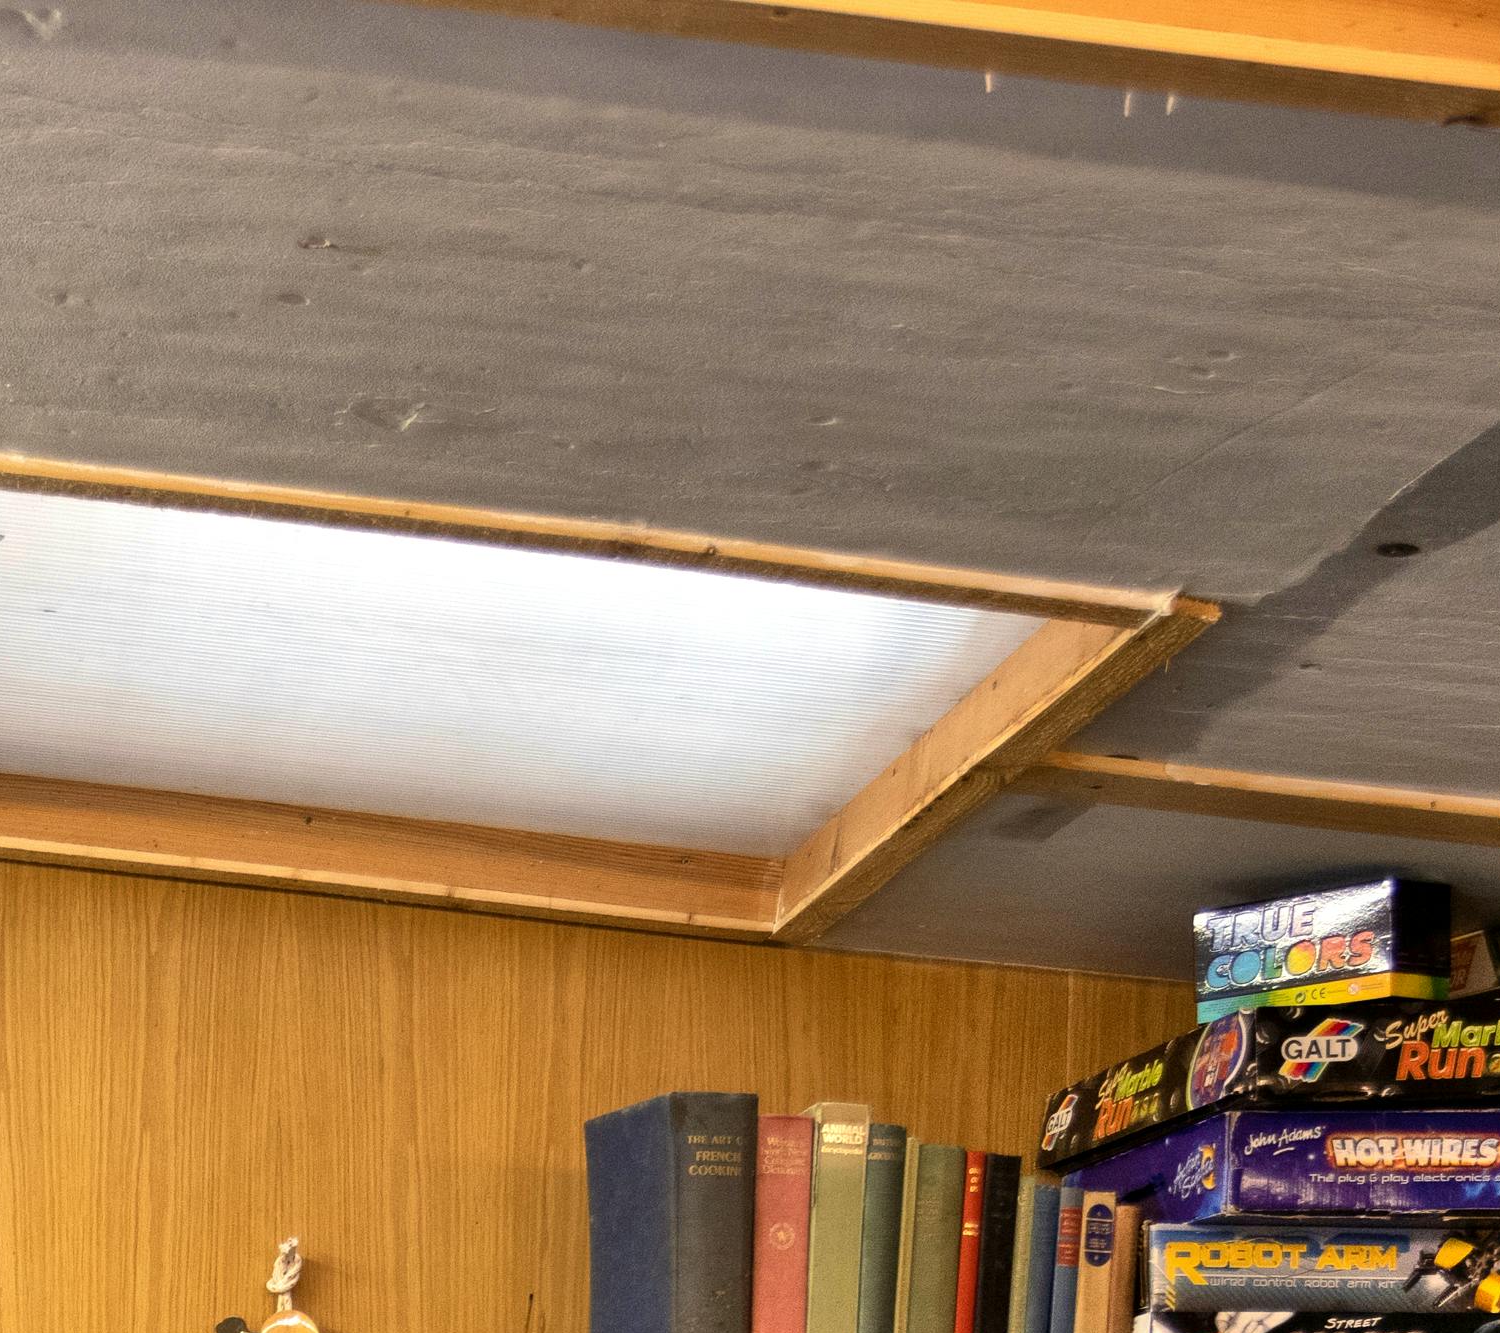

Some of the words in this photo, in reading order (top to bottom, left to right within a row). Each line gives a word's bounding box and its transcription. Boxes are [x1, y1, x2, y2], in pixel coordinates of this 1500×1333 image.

[1206, 901, 1316, 951] TRUE
[1206, 931, 1376, 989] COLORS
[1385, 1009, 1450, 1050] Super
[1284, 1038, 1351, 1059] GALT
[1395, 1041, 1488, 1081] Run
[1114, 1059, 1164, 1100] Marble
[821, 1123, 867, 1136] ANIMAL
[1046, 1110, 1073, 1134] GALT
[1092, 1095, 1135, 1142] Run
[822, 1134, 864, 1146] WORLD
[1244, 1134, 1276, 1156] John
[1277, 1126, 1322, 1147] Adams
[1332, 1137, 1396, 1167] HOT
[1404, 1136, 1500, 1167] WIRES
[1309, 1173, 1334, 1184] The
[1337, 1173, 1365, 1185] plug
[1381, 1173, 1409, 1185] play
[1413, 1173, 1491, 1184] electronics
[1164, 1241, 1307, 1285] ROBOT
[1315, 1244, 1398, 1271] ARM
[1324, 1316, 1383, 1330] STREET
